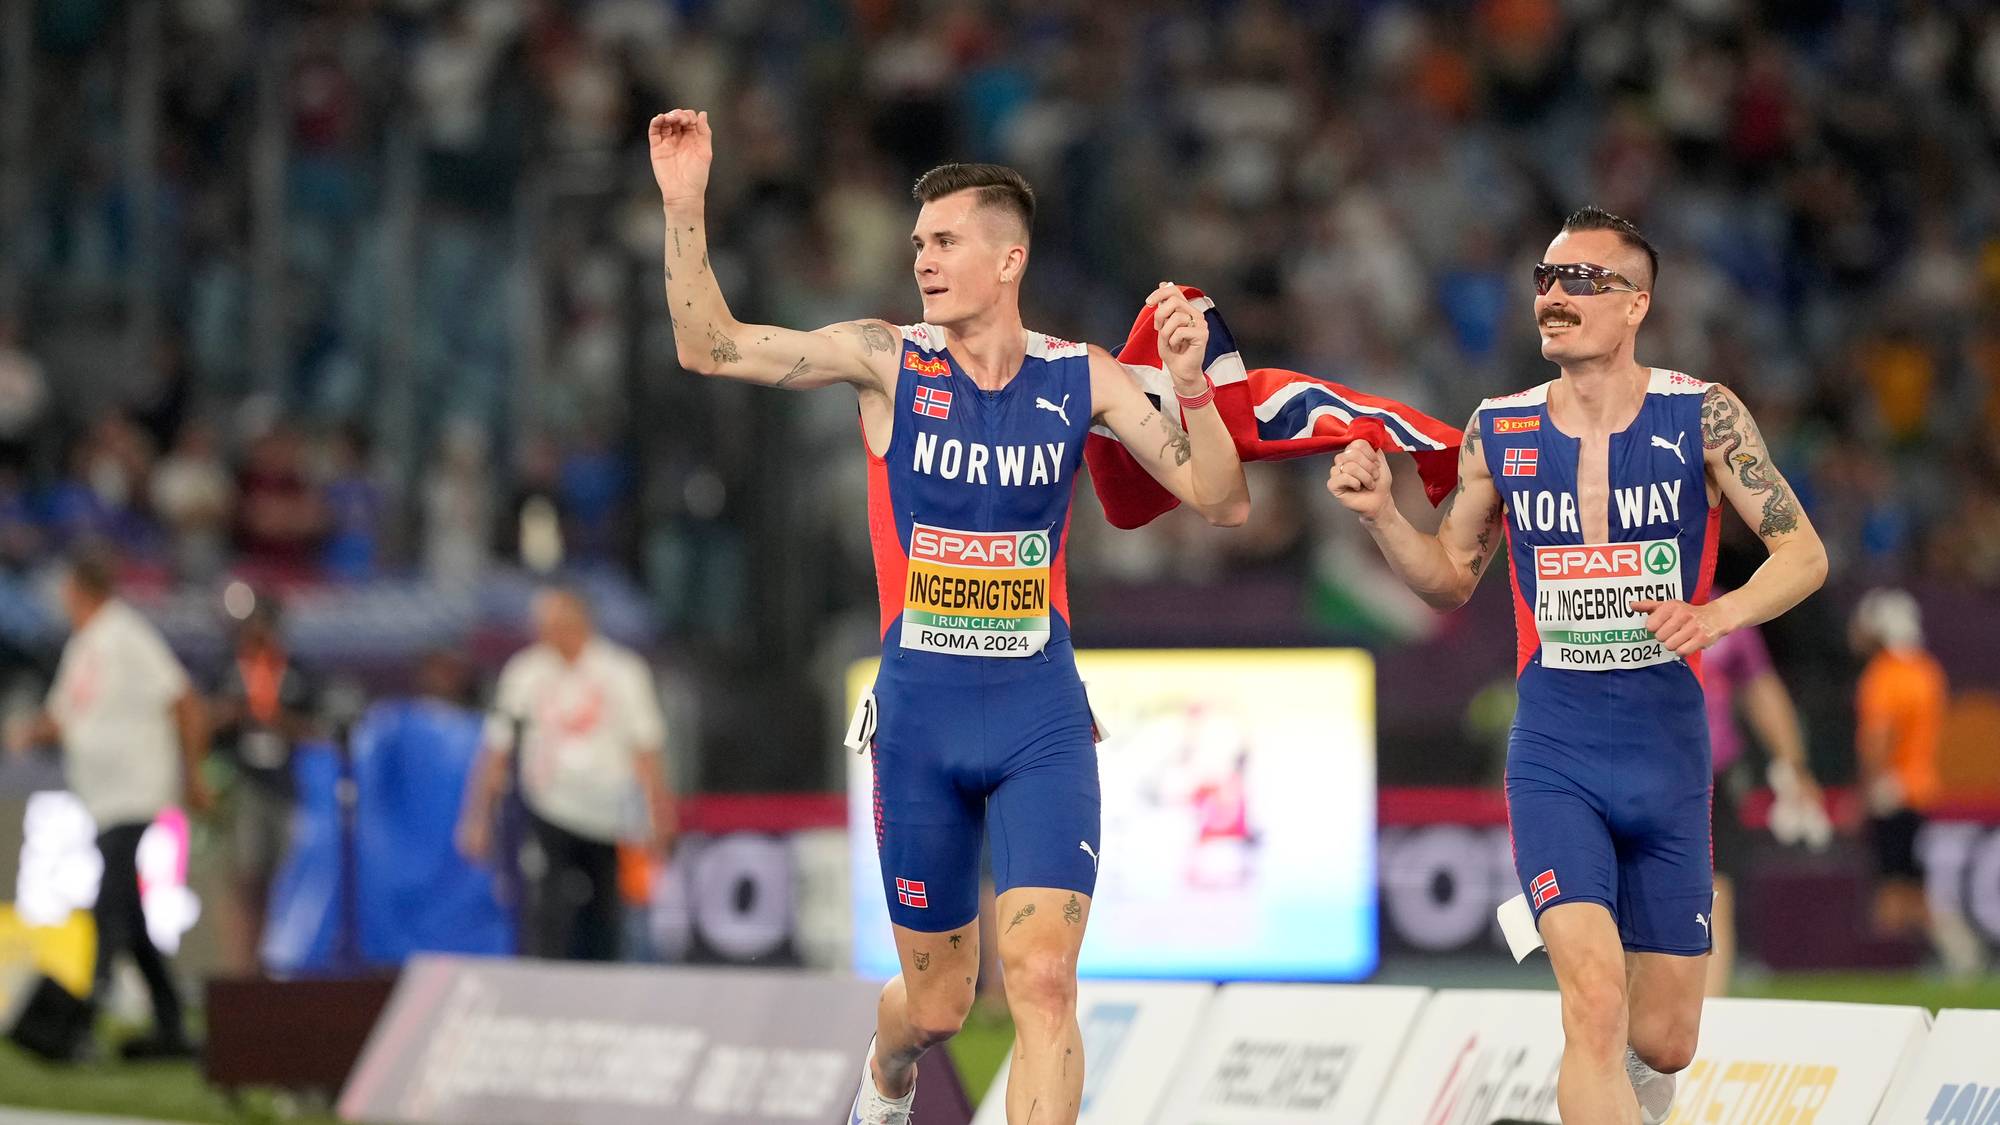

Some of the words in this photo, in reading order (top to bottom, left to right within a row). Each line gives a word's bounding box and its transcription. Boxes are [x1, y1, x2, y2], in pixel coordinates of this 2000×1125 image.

[918, 361, 946, 373] EXTRA
[1511, 420, 1540, 429] EXTRA
[912, 431, 1066, 487] NORWAY
[914, 531, 1015, 563] SPAR
[1538, 549, 1638, 576] SPAR
[909, 570, 1045, 611] INGEBRIGTSEN
[1538, 590, 1553, 622] H.
[939, 615, 968, 628] RUN
[920, 630, 979, 650] ROMA
[983, 635, 1029, 651] 2024
[1573, 632, 1600, 643] RUN
[1604, 629, 1648, 643] CLEAN
[1560, 647, 1616, 664] ROMA
[1620, 643, 1662, 663] 2024
